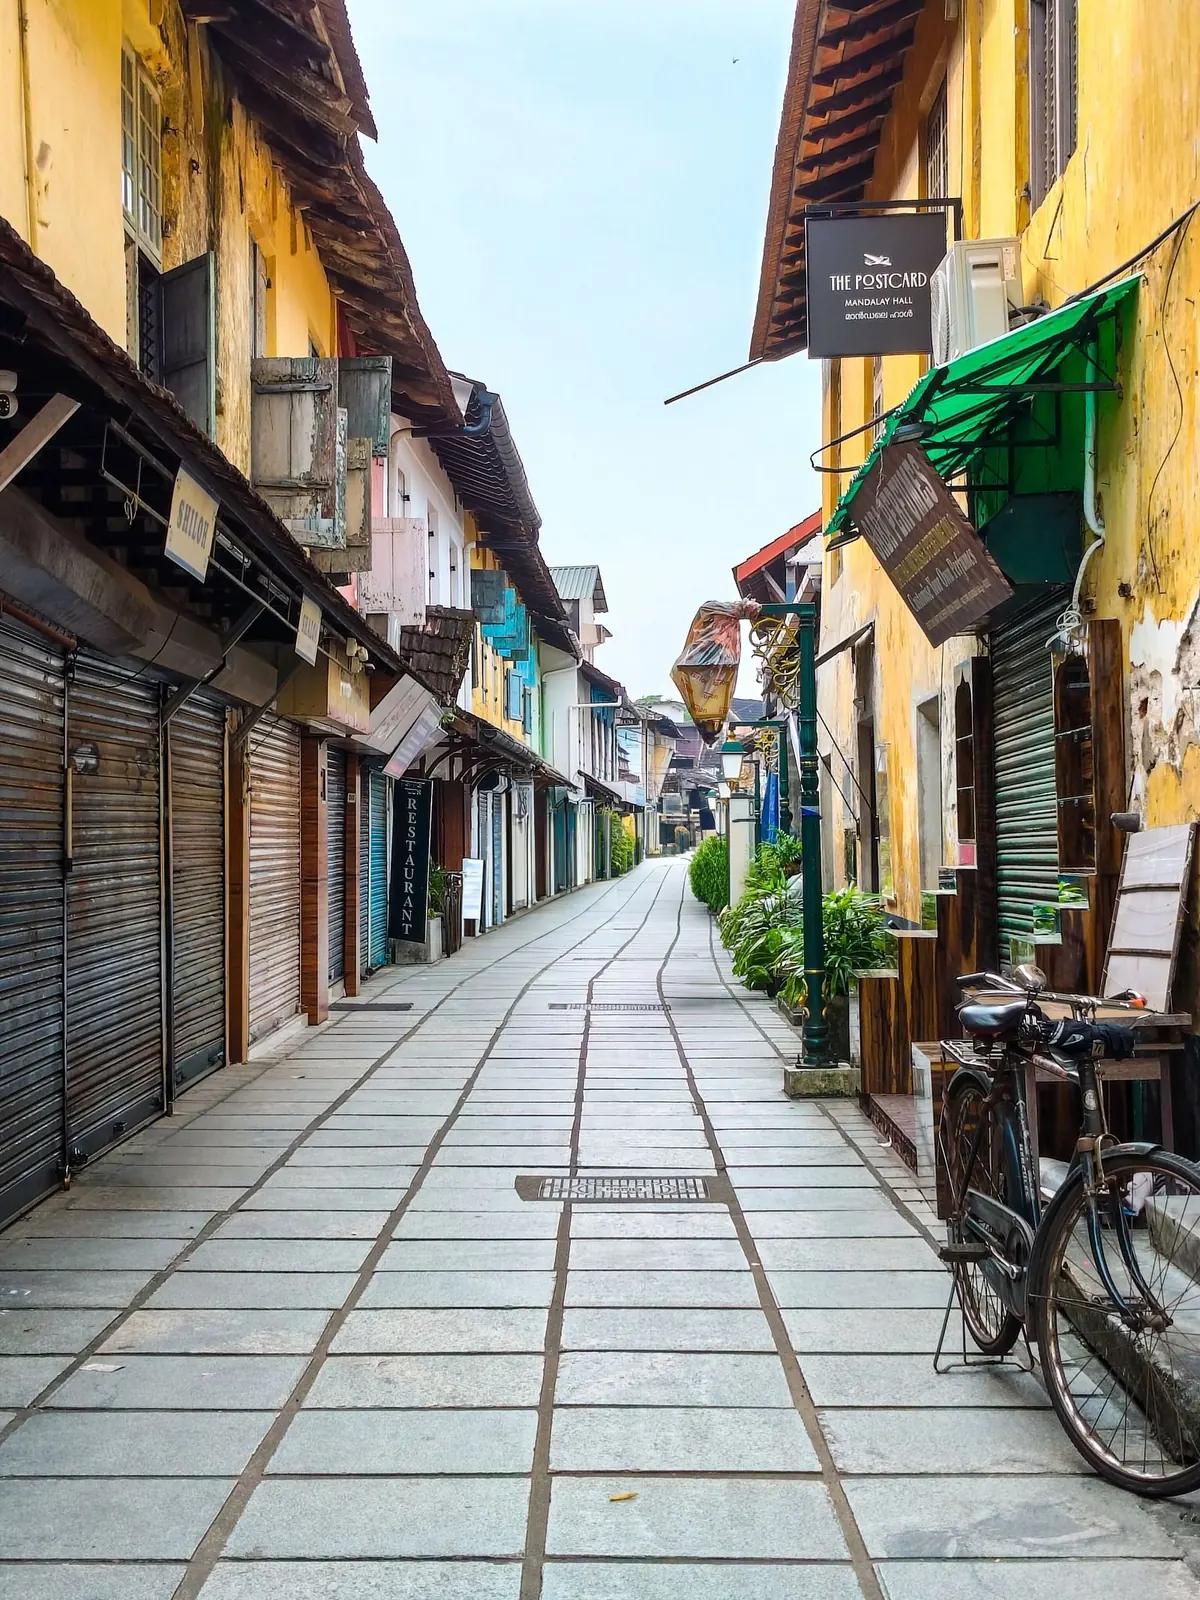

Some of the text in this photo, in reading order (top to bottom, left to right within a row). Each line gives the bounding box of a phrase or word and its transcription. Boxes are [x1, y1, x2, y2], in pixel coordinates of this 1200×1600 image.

[829, 272, 927, 291] THE POSTCARD
[844, 296, 913, 307] MANDALAY HALL
[177, 499, 209, 550] SHILOH
[877, 452, 939, 543] PERFUMES
[860, 503, 899, 561] SABA
[402, 797, 417, 935] RESTAURANT
